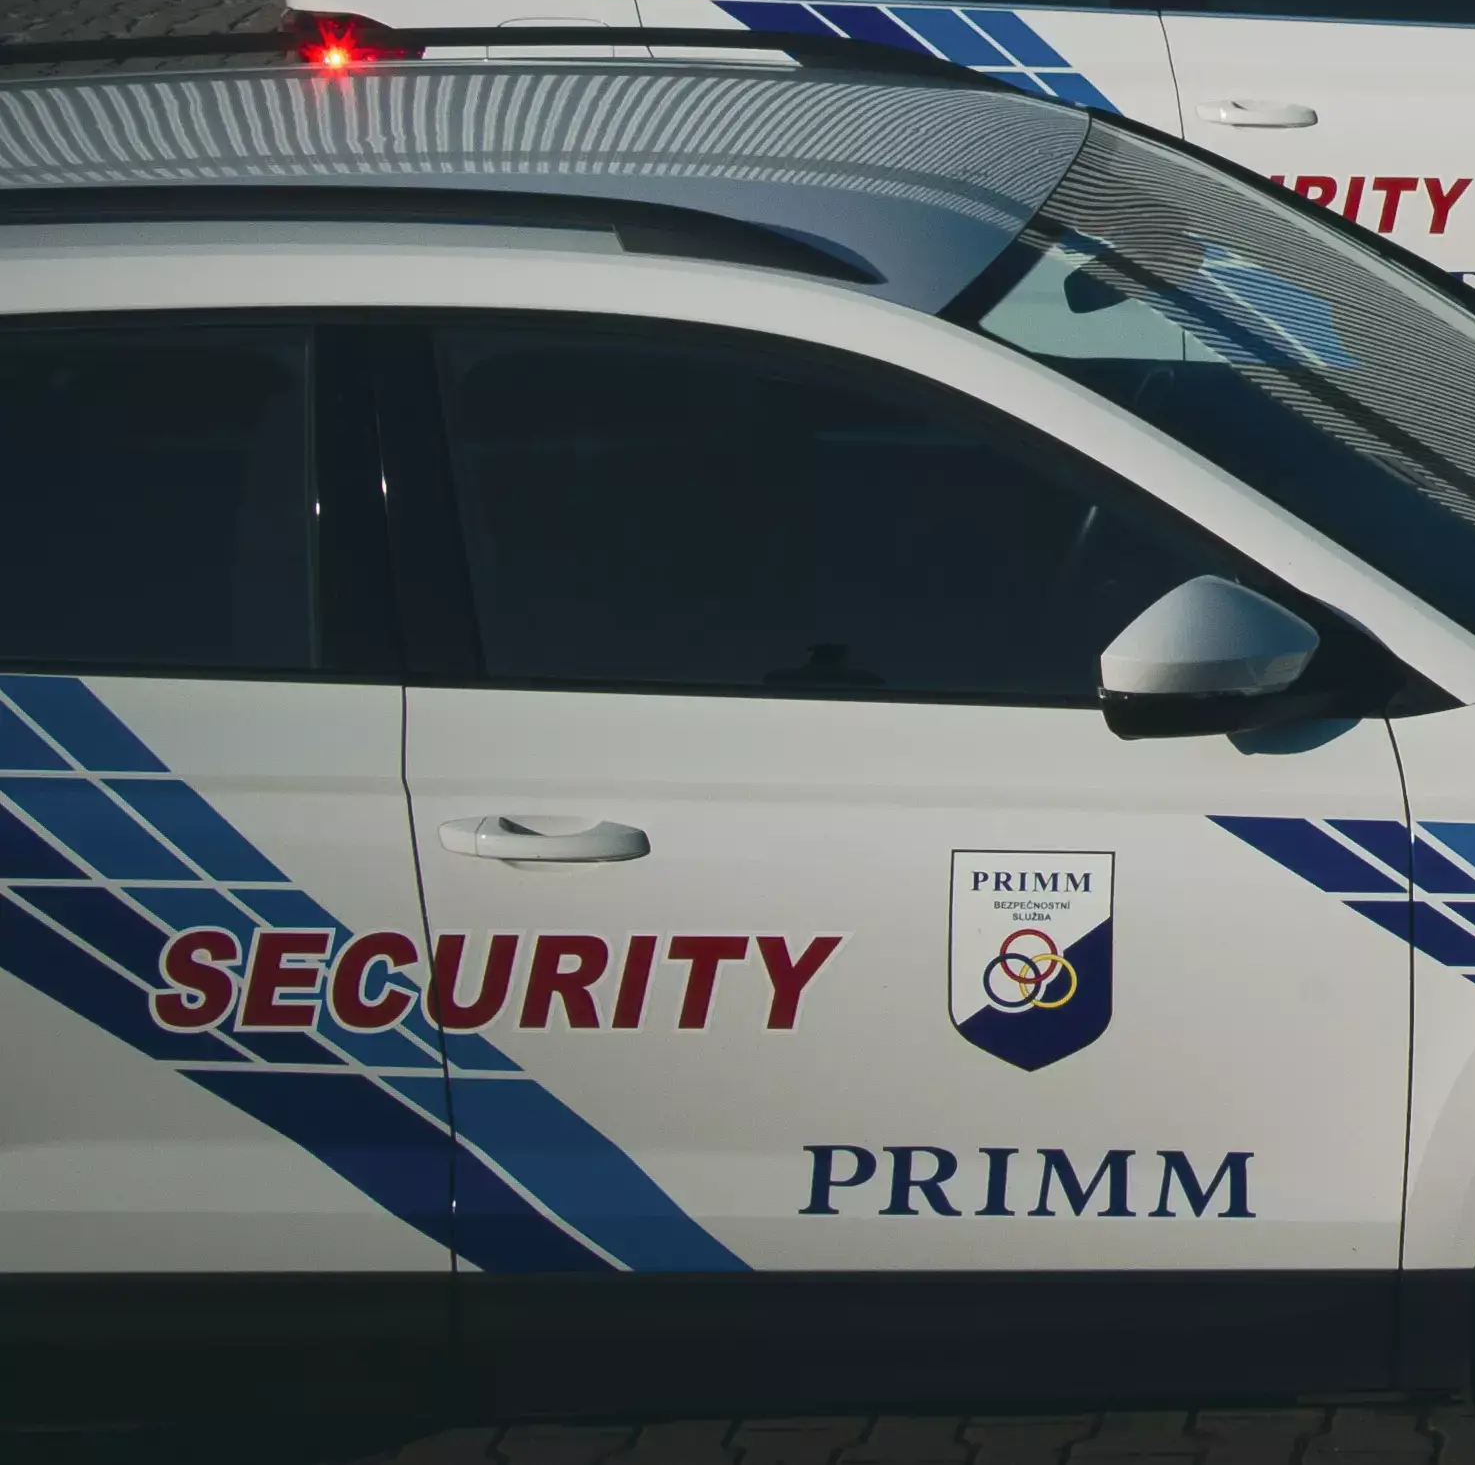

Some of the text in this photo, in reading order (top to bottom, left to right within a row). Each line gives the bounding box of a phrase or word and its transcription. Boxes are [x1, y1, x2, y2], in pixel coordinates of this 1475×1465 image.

[970, 871, 1093, 893] PRIMM
[993, 900, 1071, 910] BEZPEČNOSTNÍ
[1012, 911, 1052, 921] SLUŽBA
[156, 930, 844, 1030] SECURITY
[798, 1144, 1258, 1219] PRIMM
